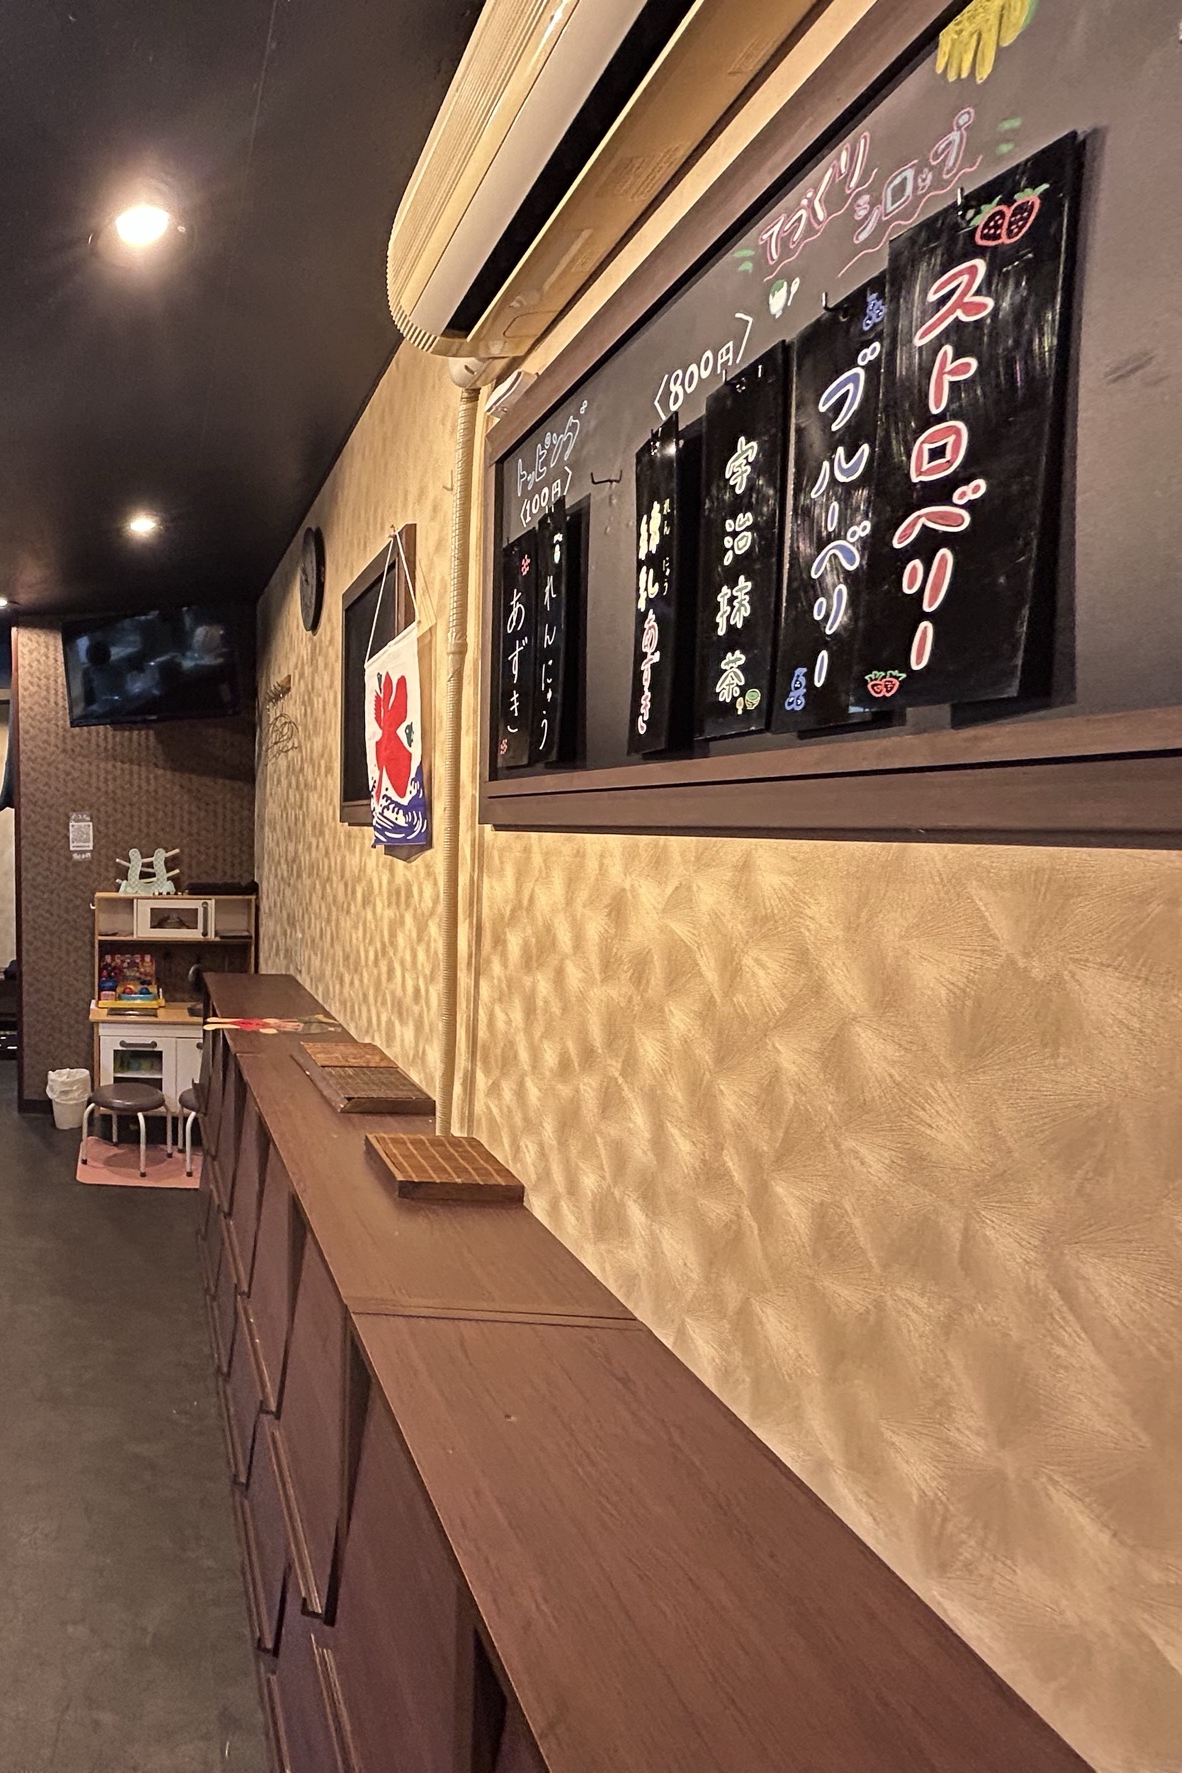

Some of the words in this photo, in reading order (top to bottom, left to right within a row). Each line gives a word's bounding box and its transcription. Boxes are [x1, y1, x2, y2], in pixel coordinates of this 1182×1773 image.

[854, 107, 975, 244] シロップ
[716, 437, 758, 702] 宇治抹茶
[810, 342, 881, 688] ブルーベリー
[893, 258, 995, 671] ストロベリー
[507, 588, 529, 734] あずき
[538, 575, 557, 751] れんにゅう
